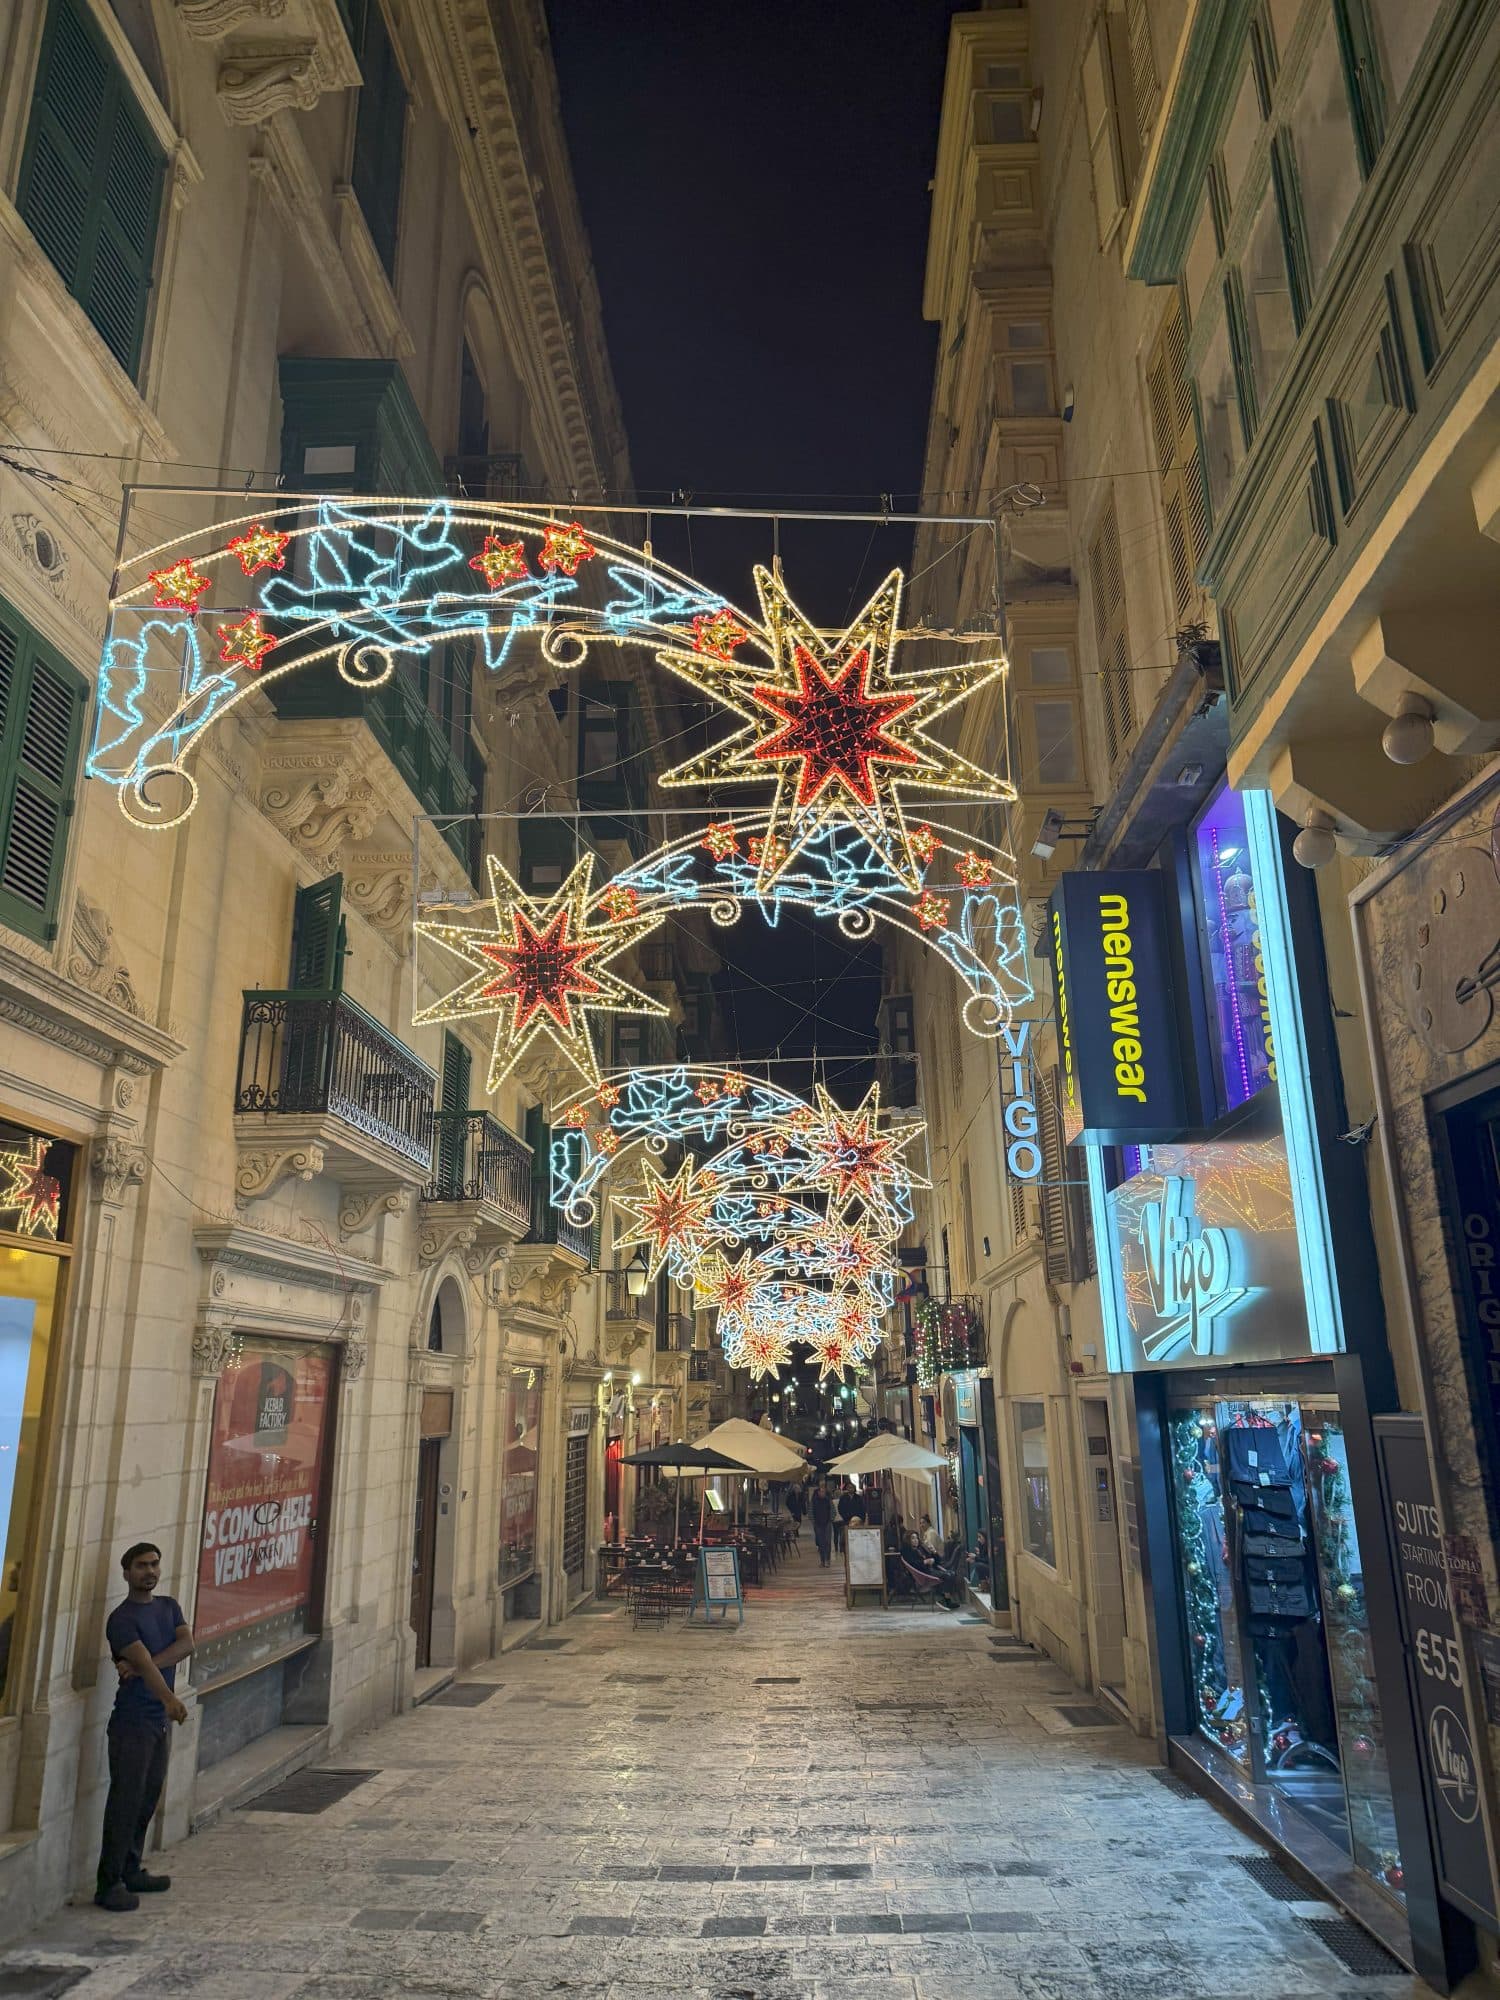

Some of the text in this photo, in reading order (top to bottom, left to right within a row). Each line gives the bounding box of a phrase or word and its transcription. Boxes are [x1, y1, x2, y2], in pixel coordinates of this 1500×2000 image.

[1052, 911, 1076, 1110] menswear
[1099, 894, 1148, 1104] menswear
[1001, 1021, 1043, 1179] VIGO
[1139, 1176, 1231, 1356] Vigo
[258, 1412, 287, 1429] FACTORY
[203, 1510, 217, 1549] IS
[219, 1501, 281, 1546] COMING
[1395, 1500, 1441, 1539] SUITS
[214, 1530, 299, 1587] VERY SOON!
[1401, 1542, 1447, 1570] STARTING
[1405, 1571, 1450, 1611] FROM
[1415, 1628, 1464, 1688] €55
[1432, 1719, 1469, 1803] Vigo
